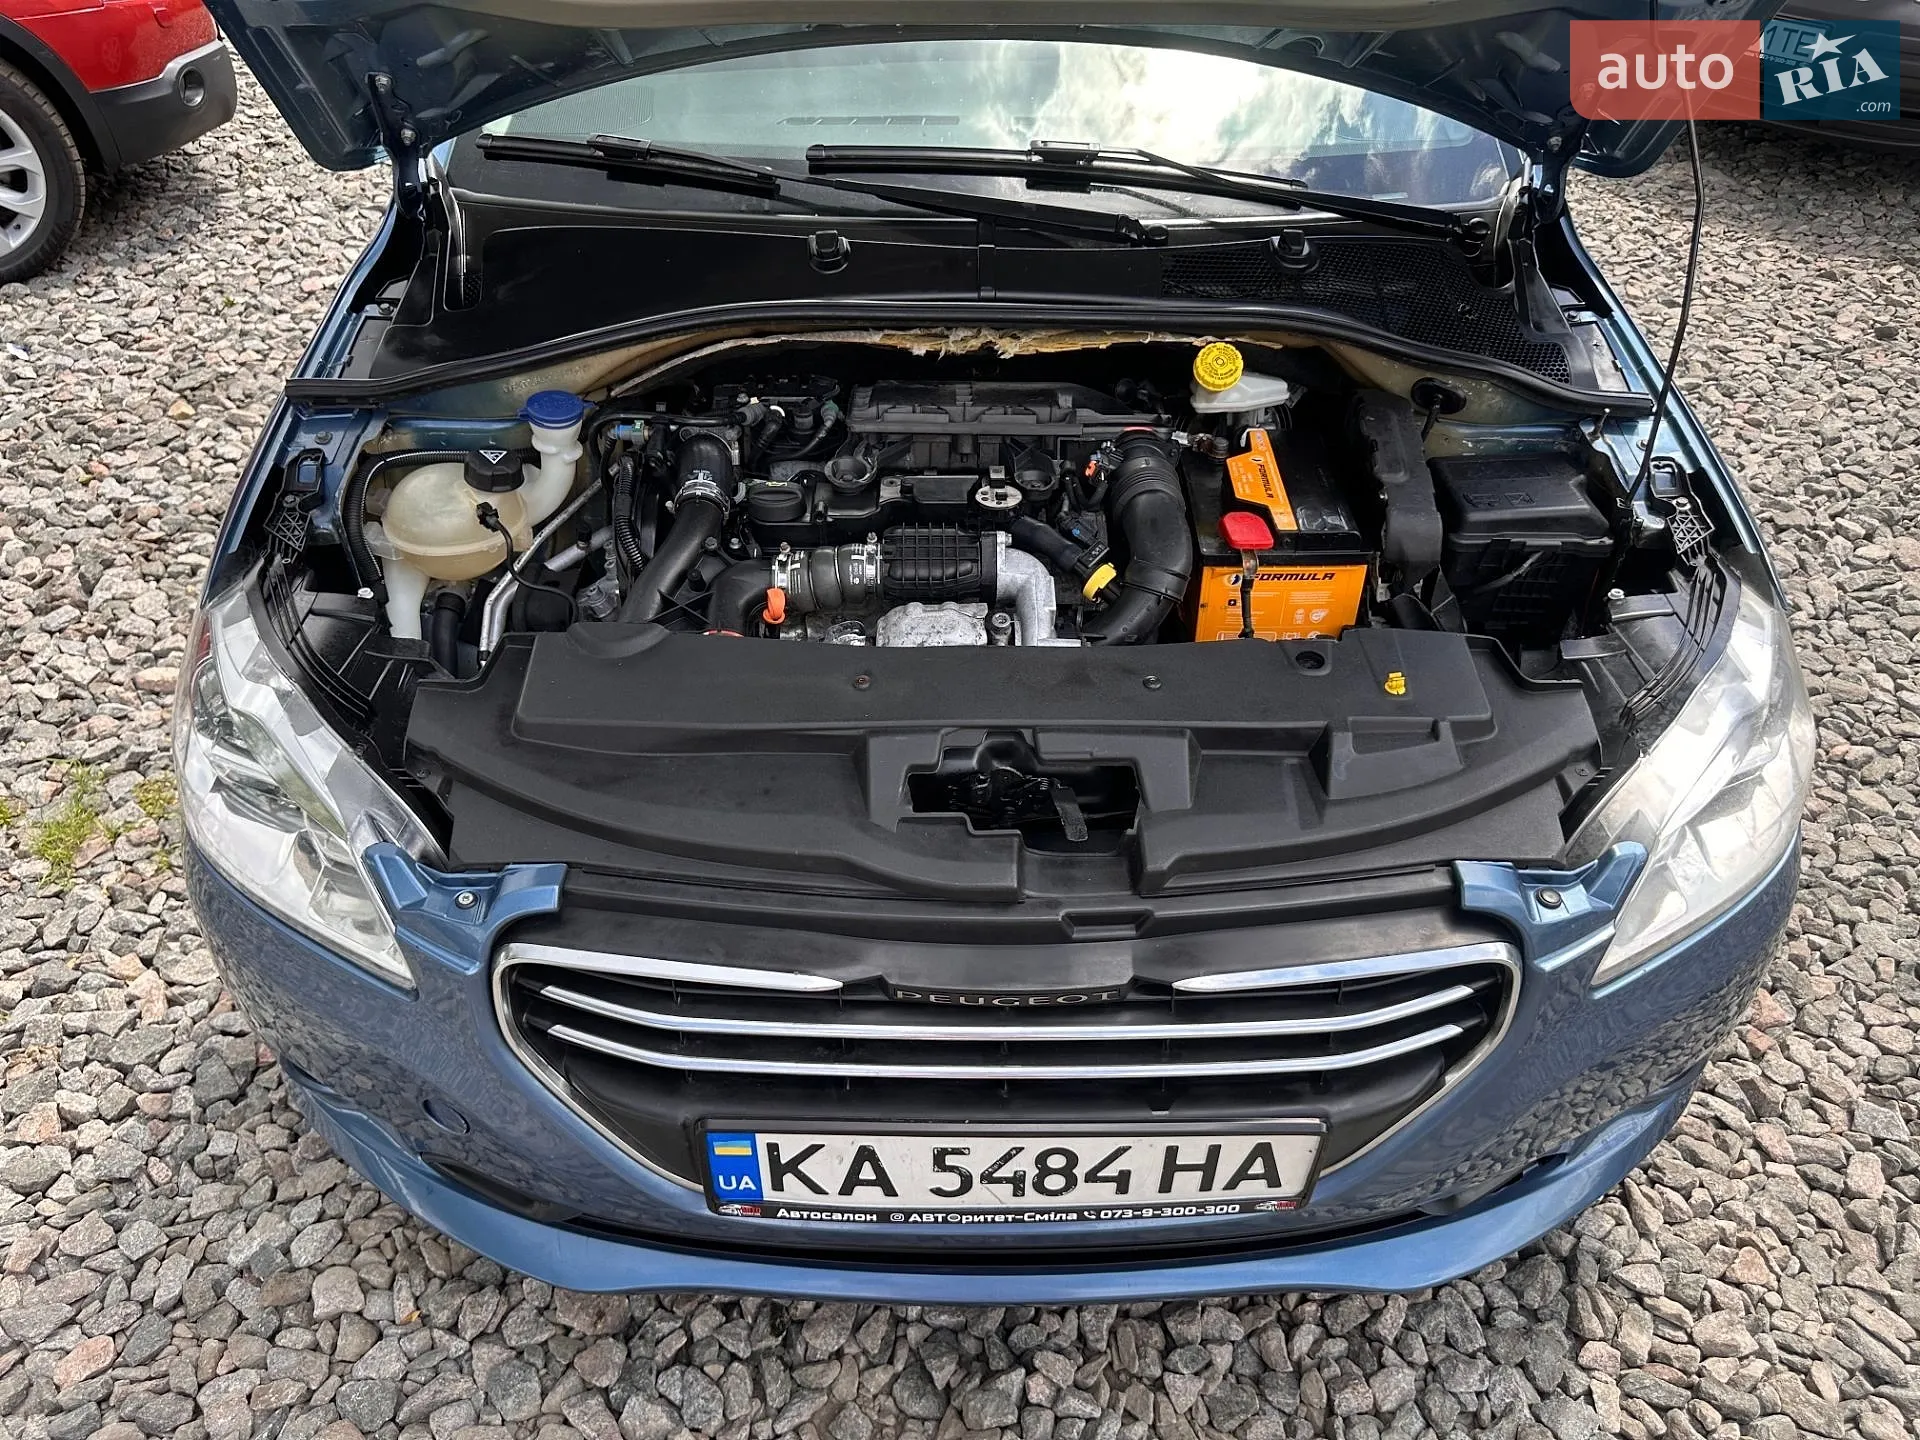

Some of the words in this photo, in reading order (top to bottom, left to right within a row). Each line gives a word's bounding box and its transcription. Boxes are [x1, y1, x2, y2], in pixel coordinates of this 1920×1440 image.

[896, 990, 1118, 1006] PEUGEOT
[766, 1141, 899, 1197] KA
[929, 1145, 1133, 1198] 5484
[1157, 1141, 1282, 1194] HA
[718, 1174, 757, 1191] UA
[776, 1208, 878, 1222] Автосалон
[1100, 1204, 1241, 1219] 073-9-300-300
